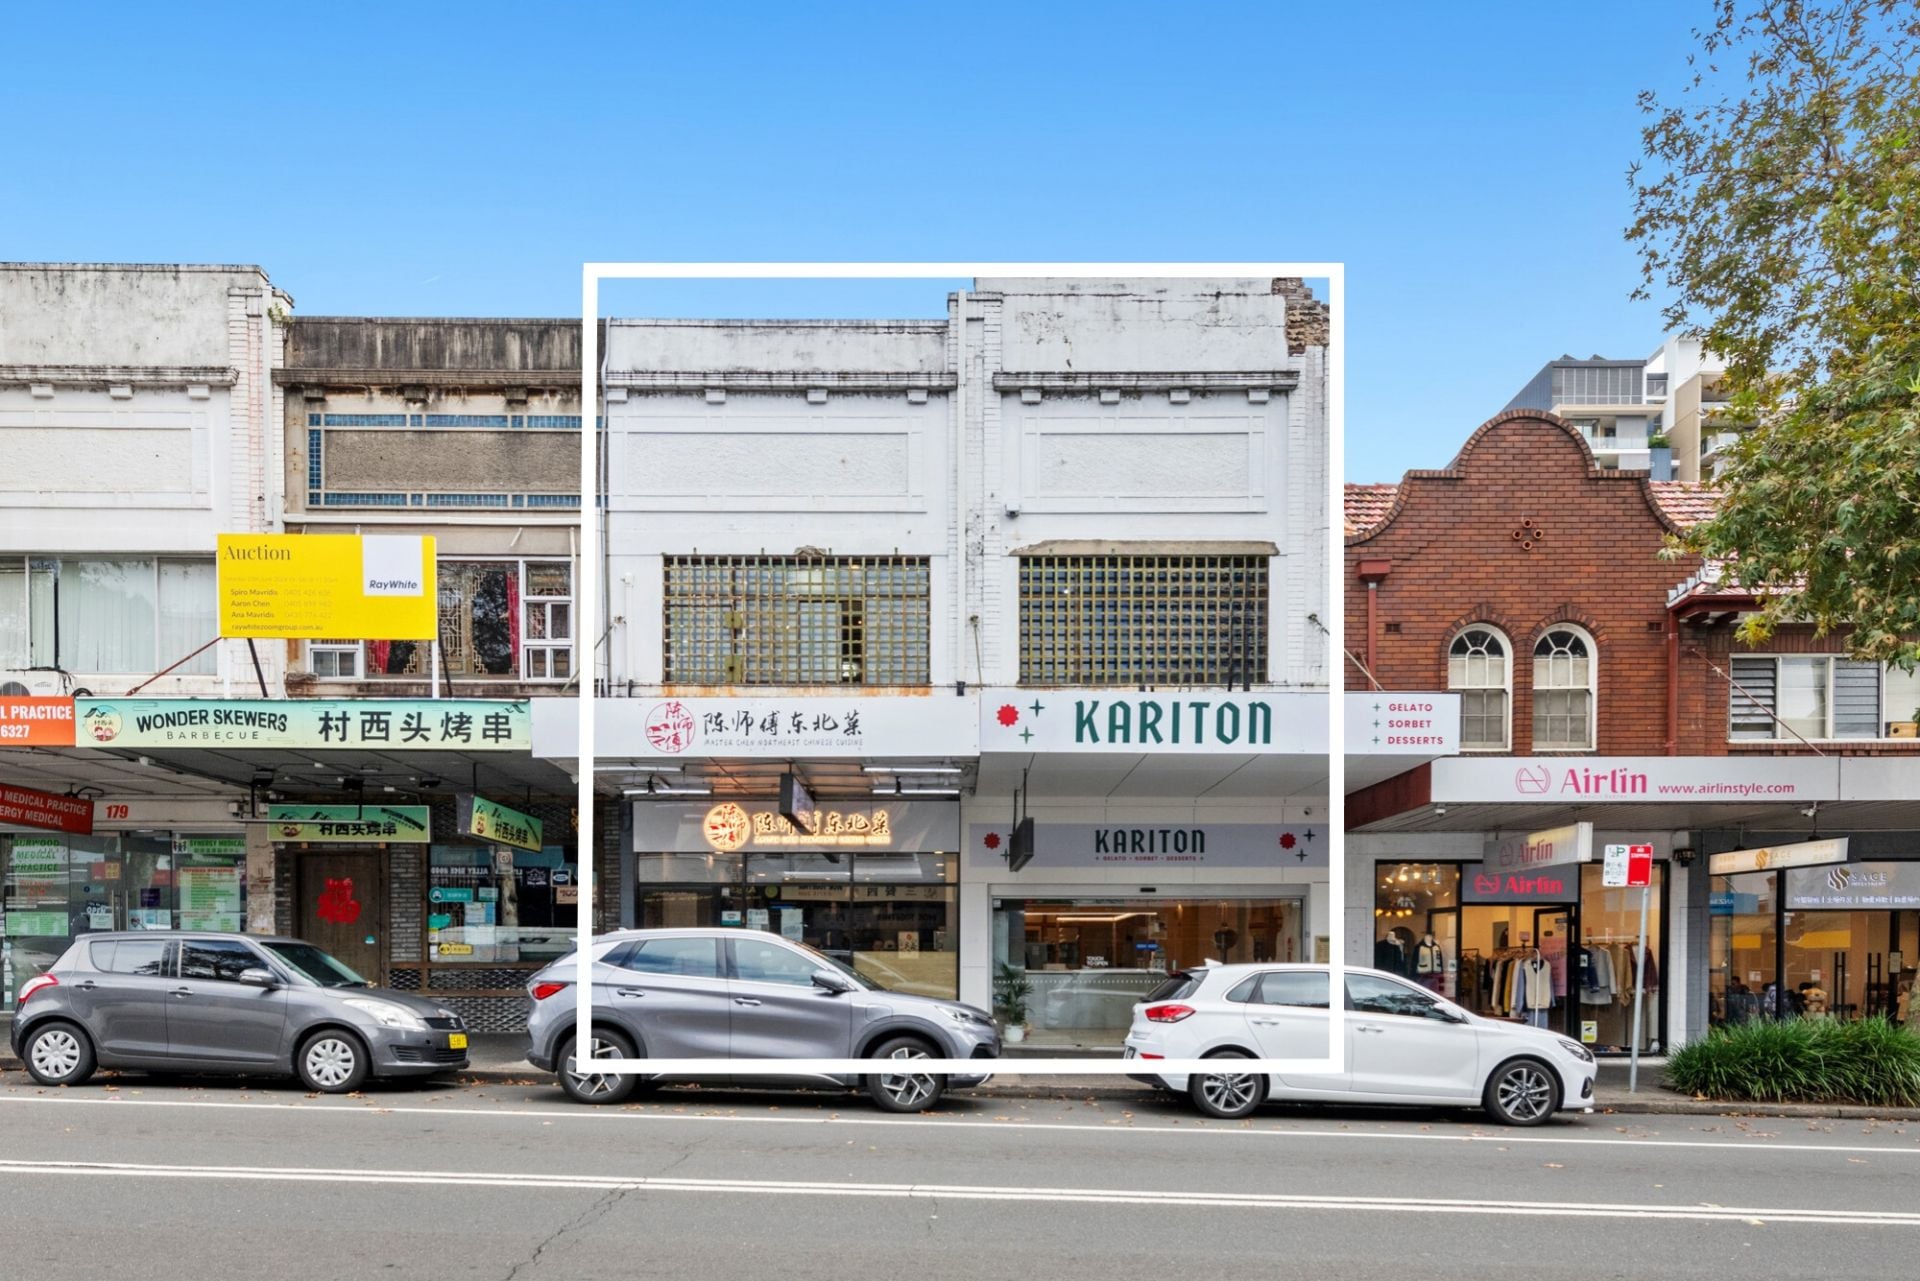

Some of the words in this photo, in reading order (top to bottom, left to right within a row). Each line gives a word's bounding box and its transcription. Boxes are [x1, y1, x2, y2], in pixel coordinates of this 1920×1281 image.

[223, 544, 291, 561] Auction
[253, 599, 271, 607] Chen
[11, 705, 72, 720] PRACTICE
[1388, 702, 1434, 712] GELATO
[136, 709, 209, 733] WONDER
[212, 709, 288, 733] SKEWERS
[318, 710, 514, 744] 村西头烤串
[703, 709, 863, 736] 陈师傅东北菜
[1075, 700, 1272, 745] KARITON
[1388, 719, 1432, 729] SORBET
[1, 725, 30, 738] 6327
[167, 731, 260, 740] BARBECUE
[1387, 735, 1444, 745] DESSERTS
[1658, 782, 1796, 796] www.airlinstyle.com
[4, 790, 45, 808] MEDICAL
[46, 799, 88, 816] PRACTICE
[24, 810, 64, 826] MEDICAL
[105, 804, 129, 819] 179
[1094, 829, 1206, 853] KARITON
